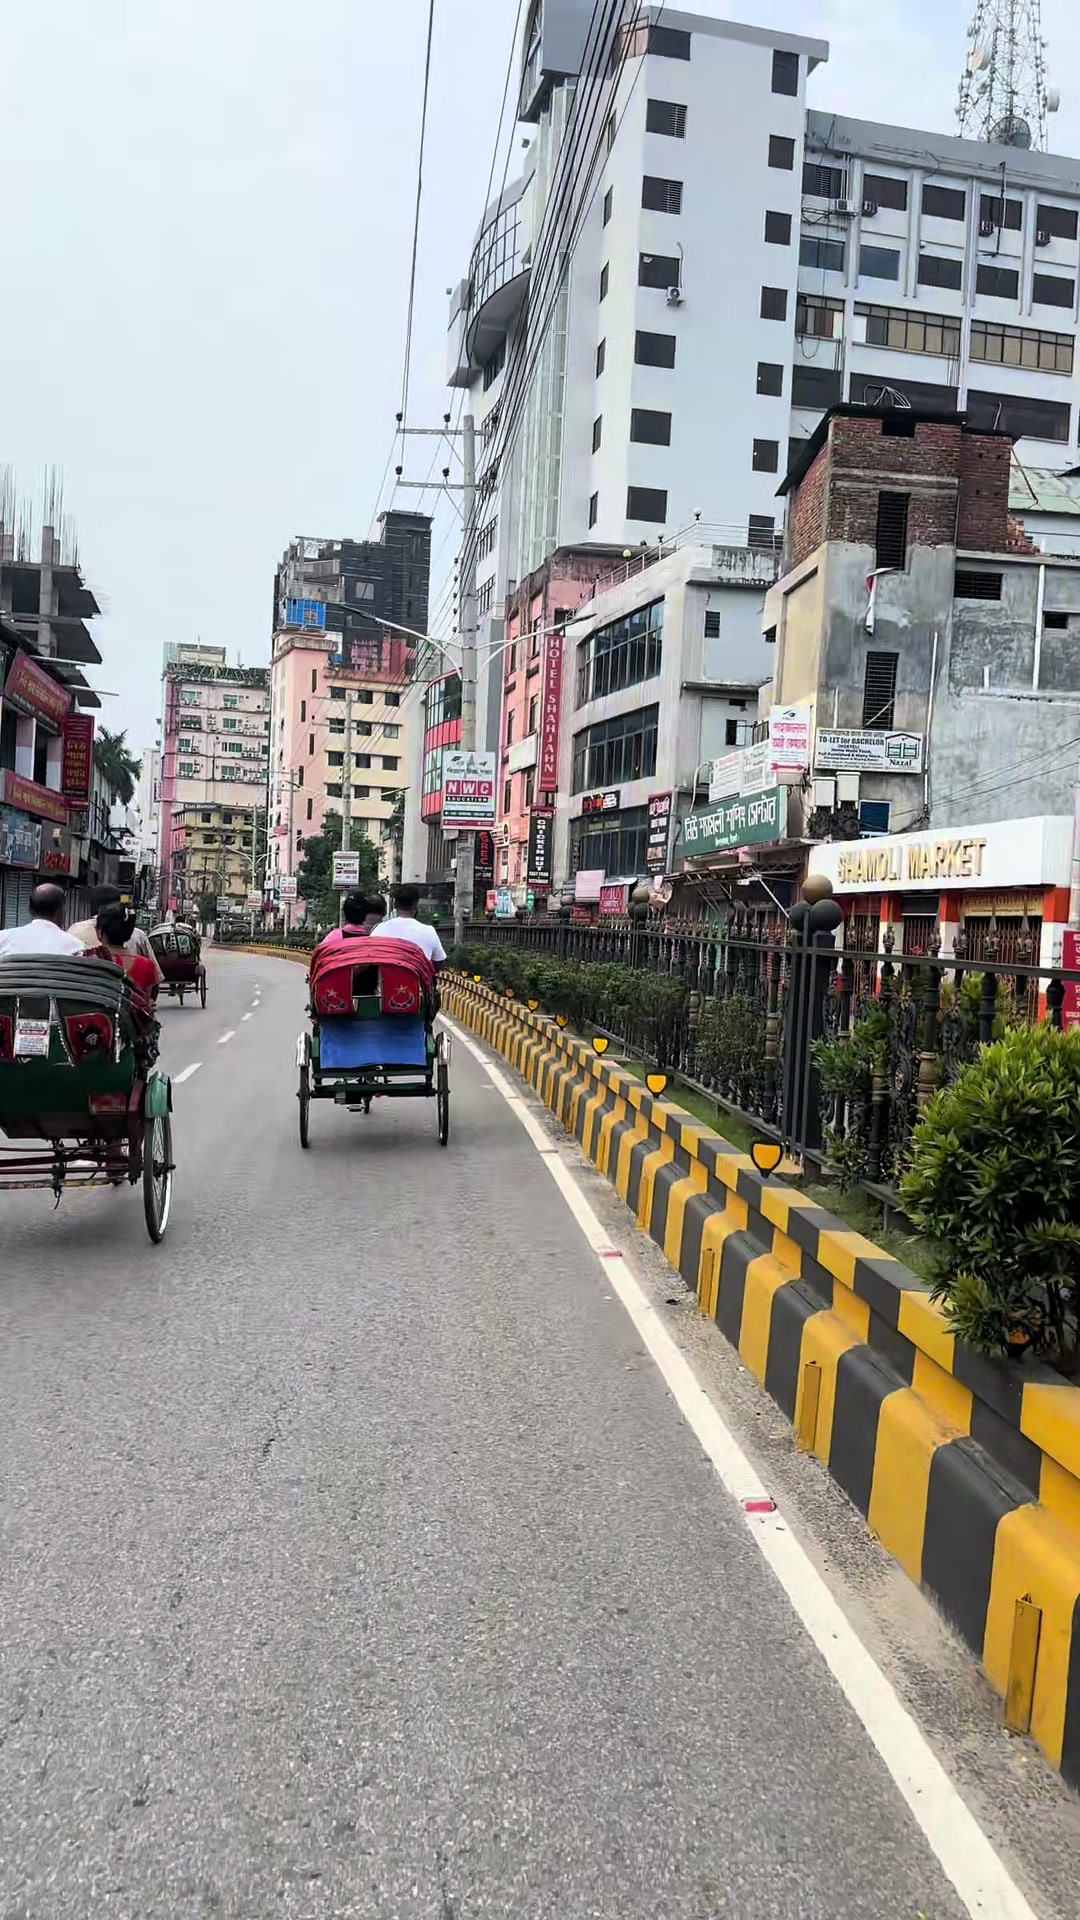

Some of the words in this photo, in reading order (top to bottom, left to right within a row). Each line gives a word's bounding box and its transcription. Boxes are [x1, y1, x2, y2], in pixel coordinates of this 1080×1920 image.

[549, 639, 560, 688] HOTEL
[544, 694, 556, 772] SHAHJAHN
[851, 738, 885, 746] BACHELOR
[447, 781, 489, 794] NWC
[535, 819, 546, 854] CHICKEN
[684, 815, 698, 841] নিউ
[699, 807, 724, 838] শ্যামলী
[726, 803, 746, 831] শপিং
[748, 795, 777, 826] সেন্টার
[533, 856, 544, 871] HUT
[838, 847, 902, 884] SHAMOLI
[907, 838, 987, 880] MARKET
